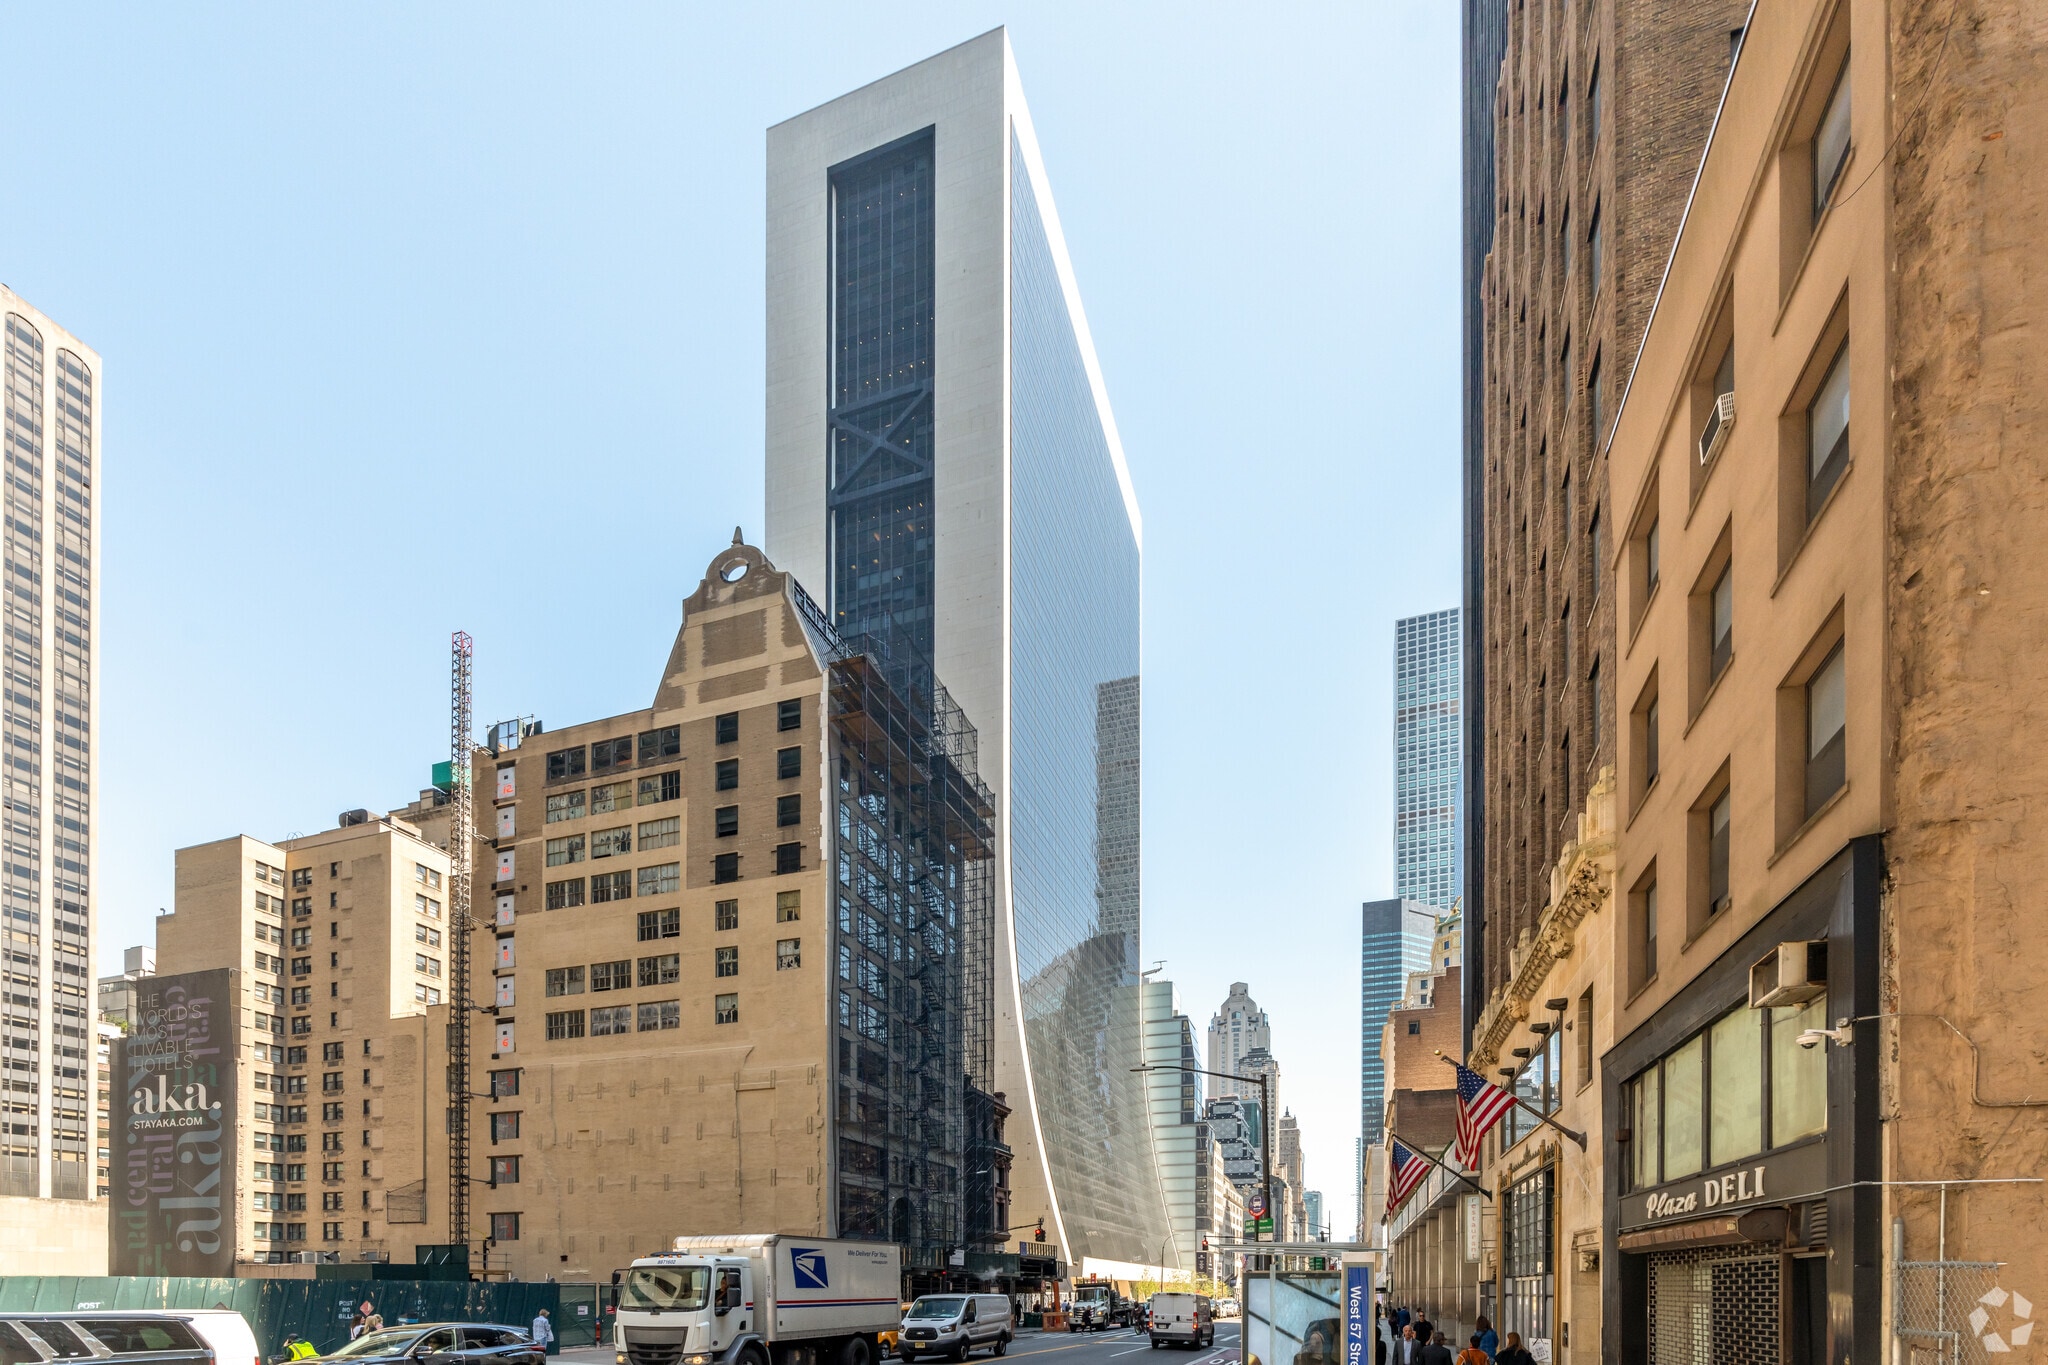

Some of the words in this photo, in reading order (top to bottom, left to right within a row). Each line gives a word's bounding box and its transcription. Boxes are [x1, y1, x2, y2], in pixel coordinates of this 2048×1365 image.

[503, 784, 513, 794] 12
[134, 1038, 194, 1058] LIVABLE
[502, 1037, 509, 1047] 6
[134, 1117, 203, 1130] STAYAKA.COM
[1646, 1192, 1698, 1219] Plaza
[1704, 1166, 1766, 1207] DELI
[77, 1302, 101, 1310] POST
[1350, 1286, 1362, 1319] West
[1350, 1323, 1362, 1339] 57
